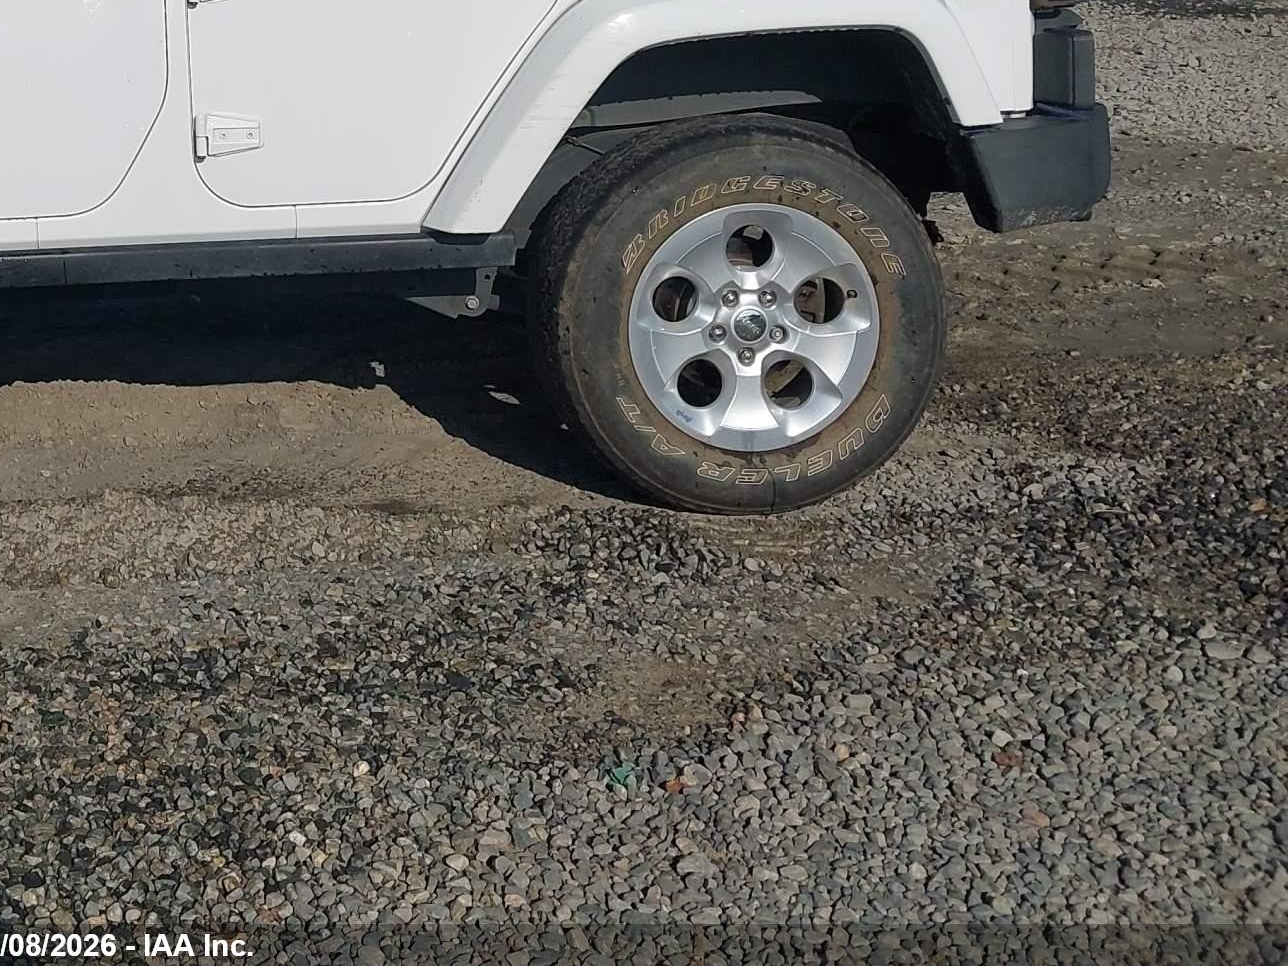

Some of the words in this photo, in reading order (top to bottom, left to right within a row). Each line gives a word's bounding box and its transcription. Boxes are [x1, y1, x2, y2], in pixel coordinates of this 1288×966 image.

[622, 175, 907, 277] BRIDGESTONE
[616, 397, 686, 456] A/T
[696, 394, 891, 484] DUELER
